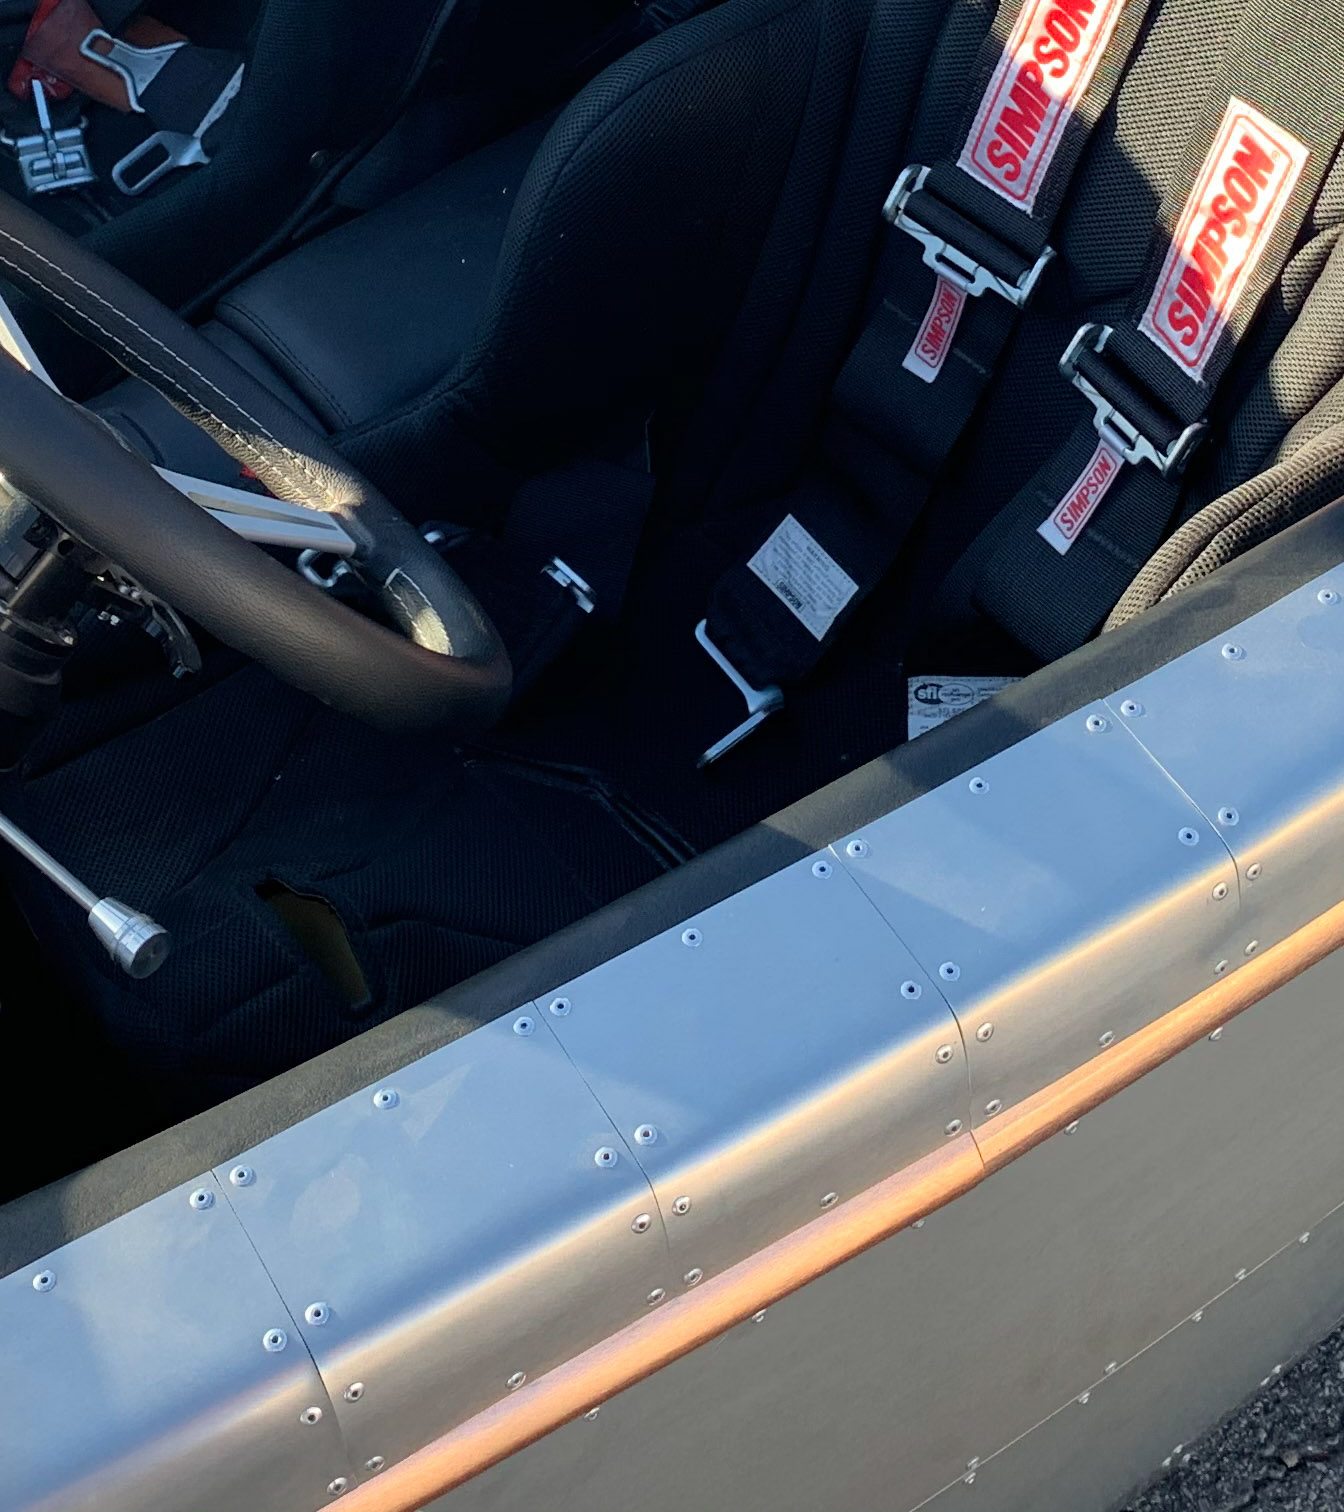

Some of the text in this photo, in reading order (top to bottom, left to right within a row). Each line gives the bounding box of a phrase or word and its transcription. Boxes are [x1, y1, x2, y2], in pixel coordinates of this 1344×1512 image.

[1167, 133, 1276, 347] SIMPSON
[921, 288, 957, 361] SIMPSON
[1060, 454, 1112, 532] SIMPSON
